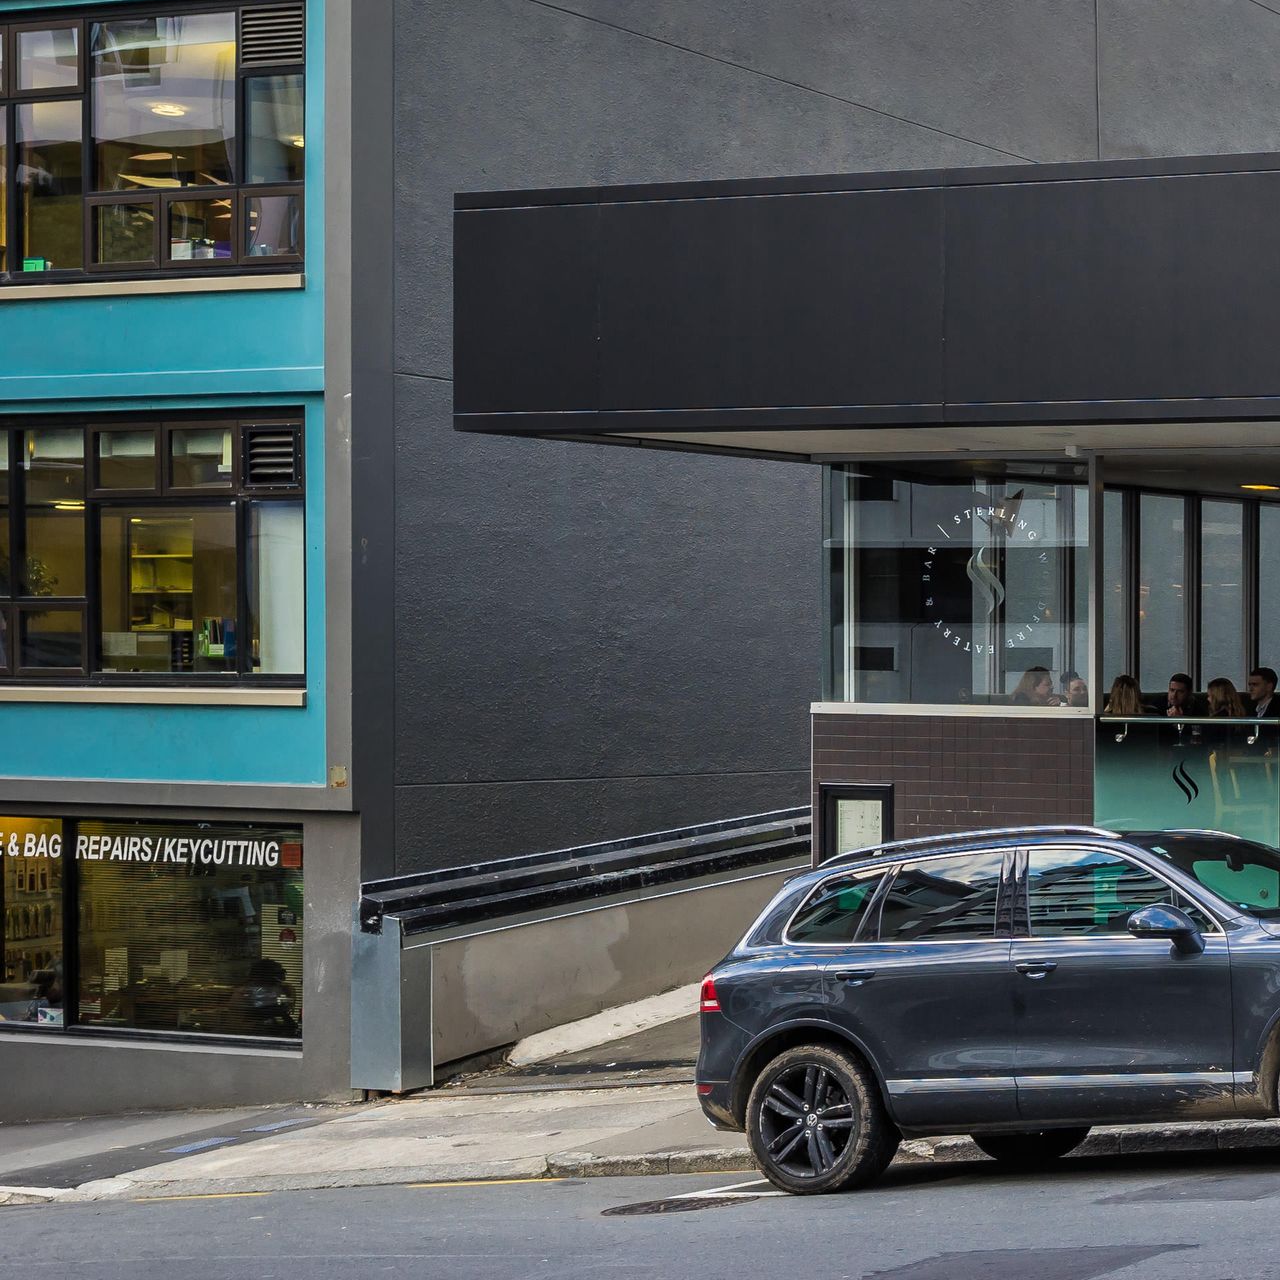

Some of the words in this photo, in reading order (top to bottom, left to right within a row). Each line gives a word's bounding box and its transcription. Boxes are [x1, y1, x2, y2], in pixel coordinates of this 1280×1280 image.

[953, 506, 1037, 540] STERLING
[922, 546, 937, 582] BAR
[934, 619, 995, 654] EATERY
[8, 832, 19, 856] &
[23, 832, 62, 858] BAG
